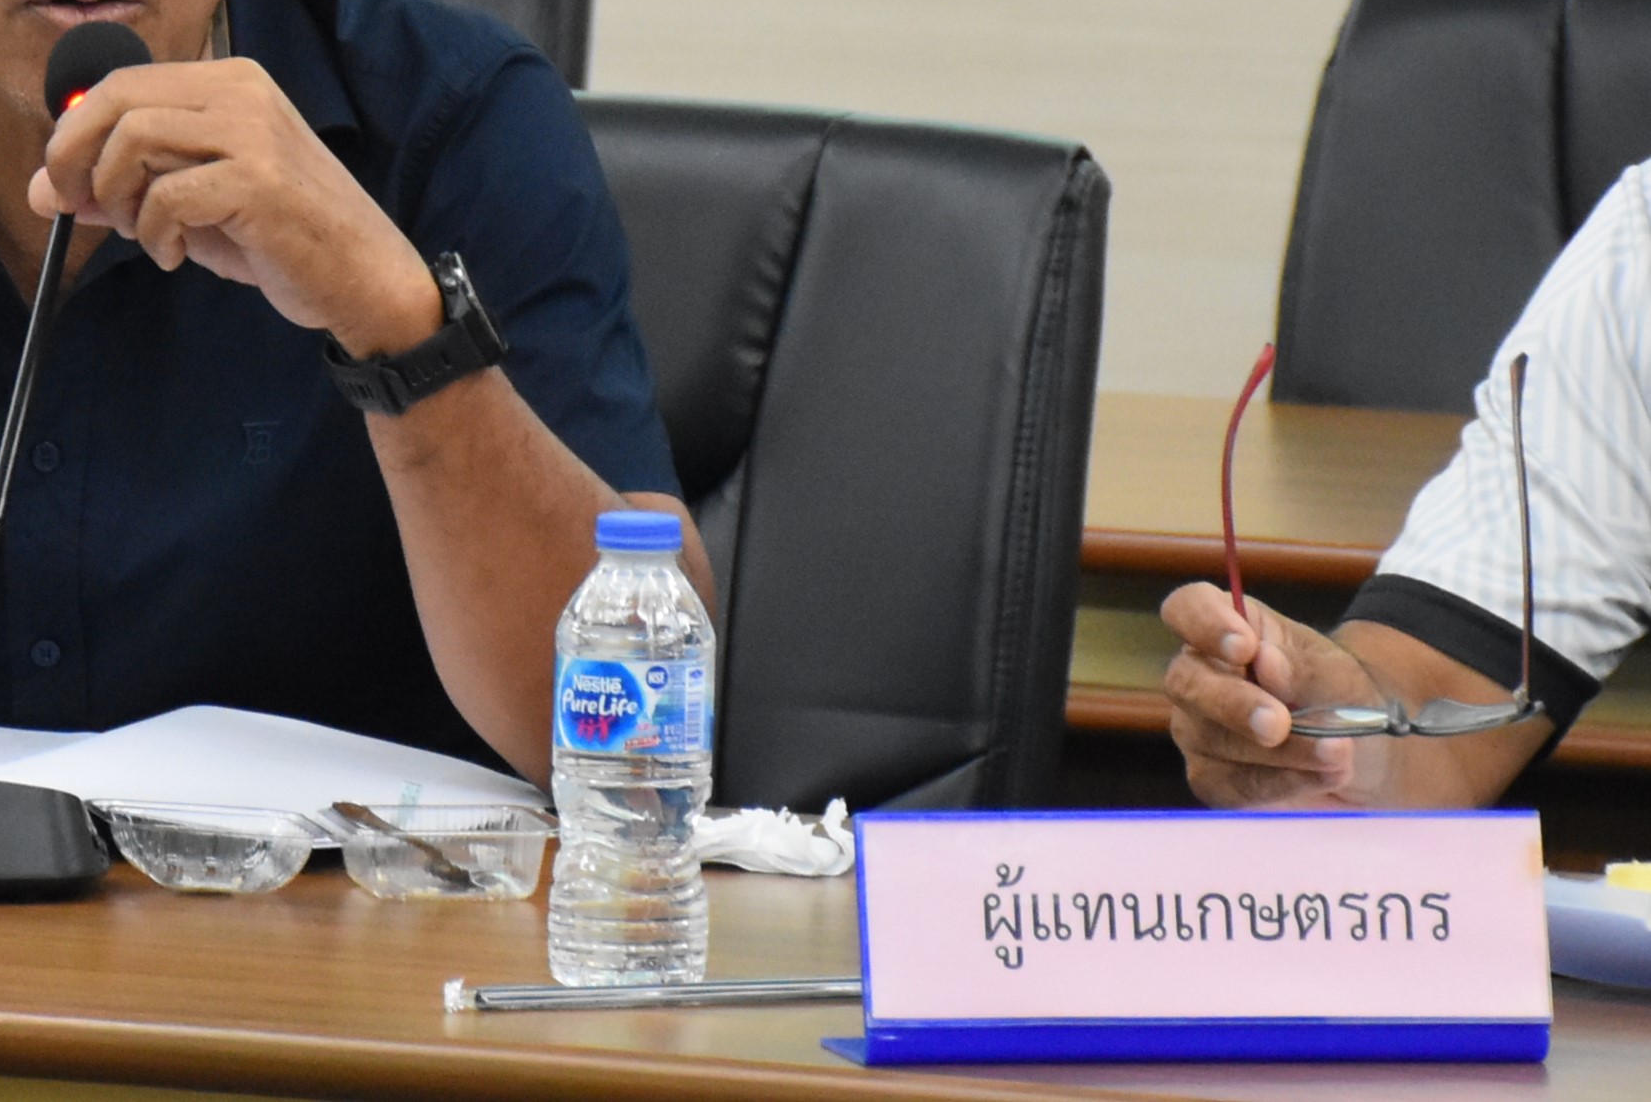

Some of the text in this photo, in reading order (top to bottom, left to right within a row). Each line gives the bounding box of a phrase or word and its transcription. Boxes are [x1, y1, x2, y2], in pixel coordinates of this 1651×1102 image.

[982, 863, 1451, 969] ผู้แทนเกษตรกร
